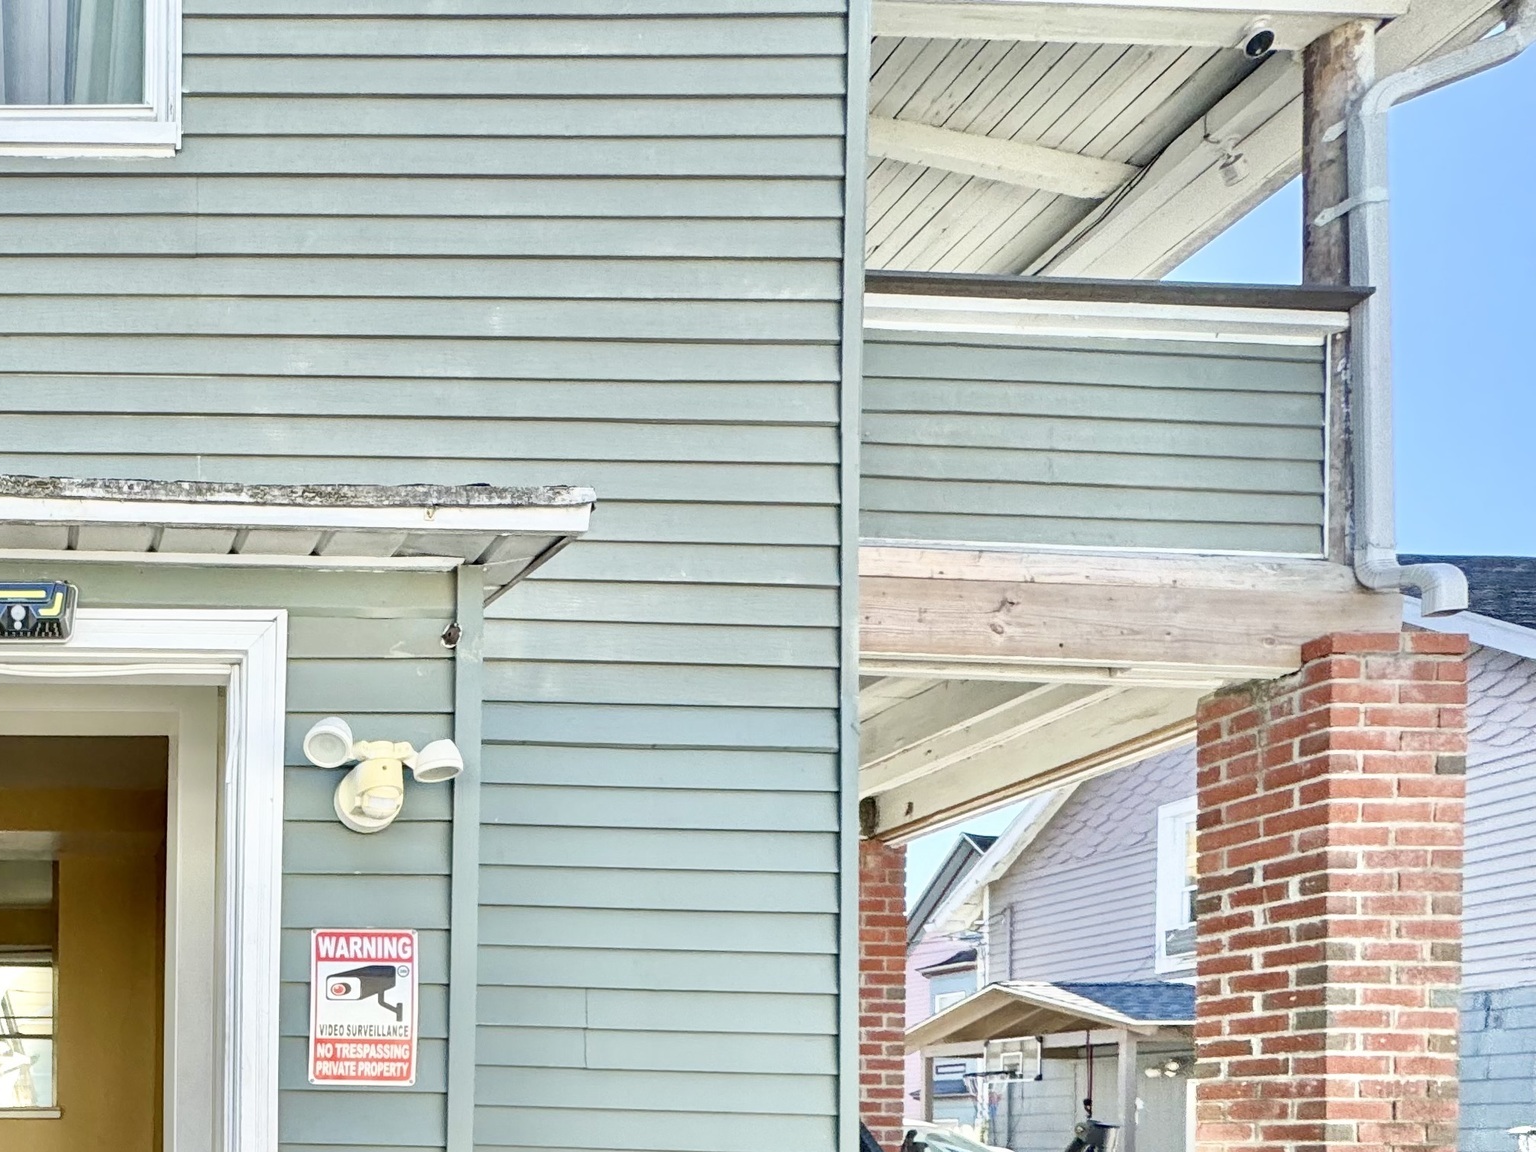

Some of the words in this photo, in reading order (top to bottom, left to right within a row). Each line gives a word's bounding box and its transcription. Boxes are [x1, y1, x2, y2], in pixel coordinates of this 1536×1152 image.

[318, 936, 412, 959] WARNING
[319, 1024, 344, 1036] VIDEO
[346, 1025, 409, 1037] SURVEILLANCE
[317, 1043, 333, 1058] NO
[335, 1043, 410, 1059] TRESPASSING
[315, 1061, 357, 1076] PRIVATE
[358, 1061, 410, 1077] PROPERTY
